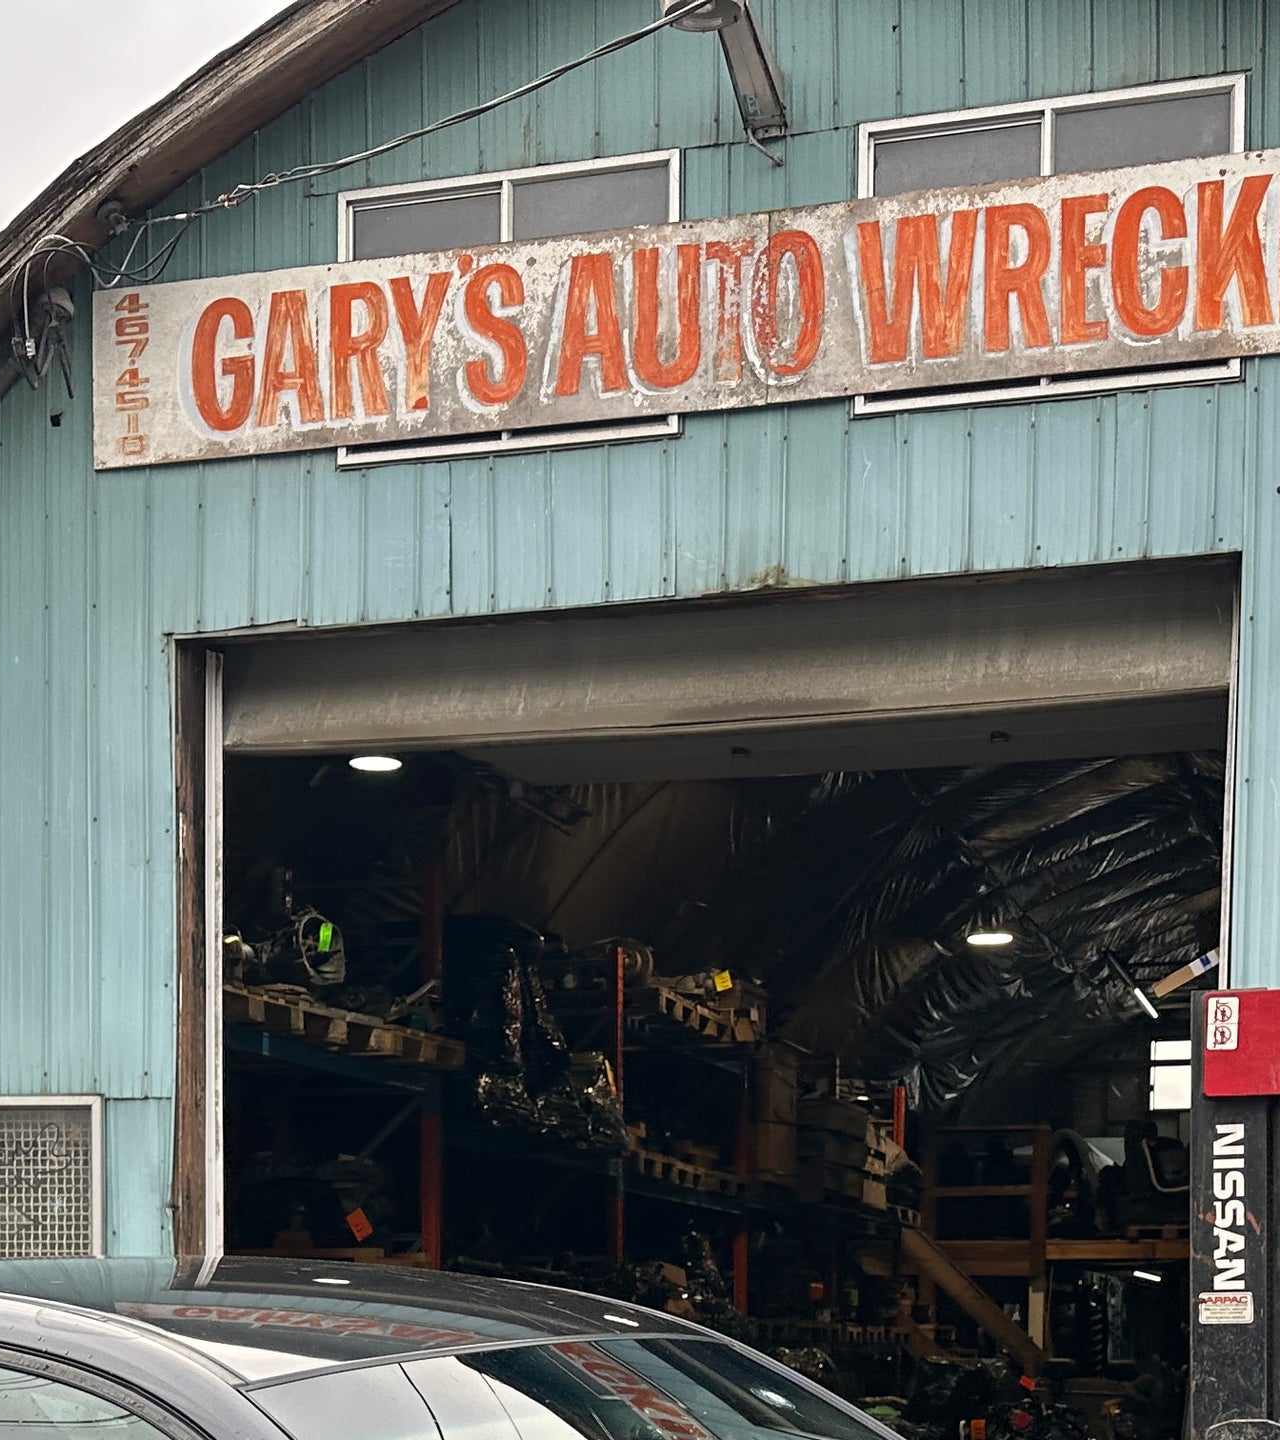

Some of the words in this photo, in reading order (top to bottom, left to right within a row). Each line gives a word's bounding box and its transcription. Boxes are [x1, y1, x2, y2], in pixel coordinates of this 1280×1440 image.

[190, 254, 527, 432] GARY'S
[556, 230, 826, 398] AUTO
[1212, 1123, 1245, 1290] NISSAN
